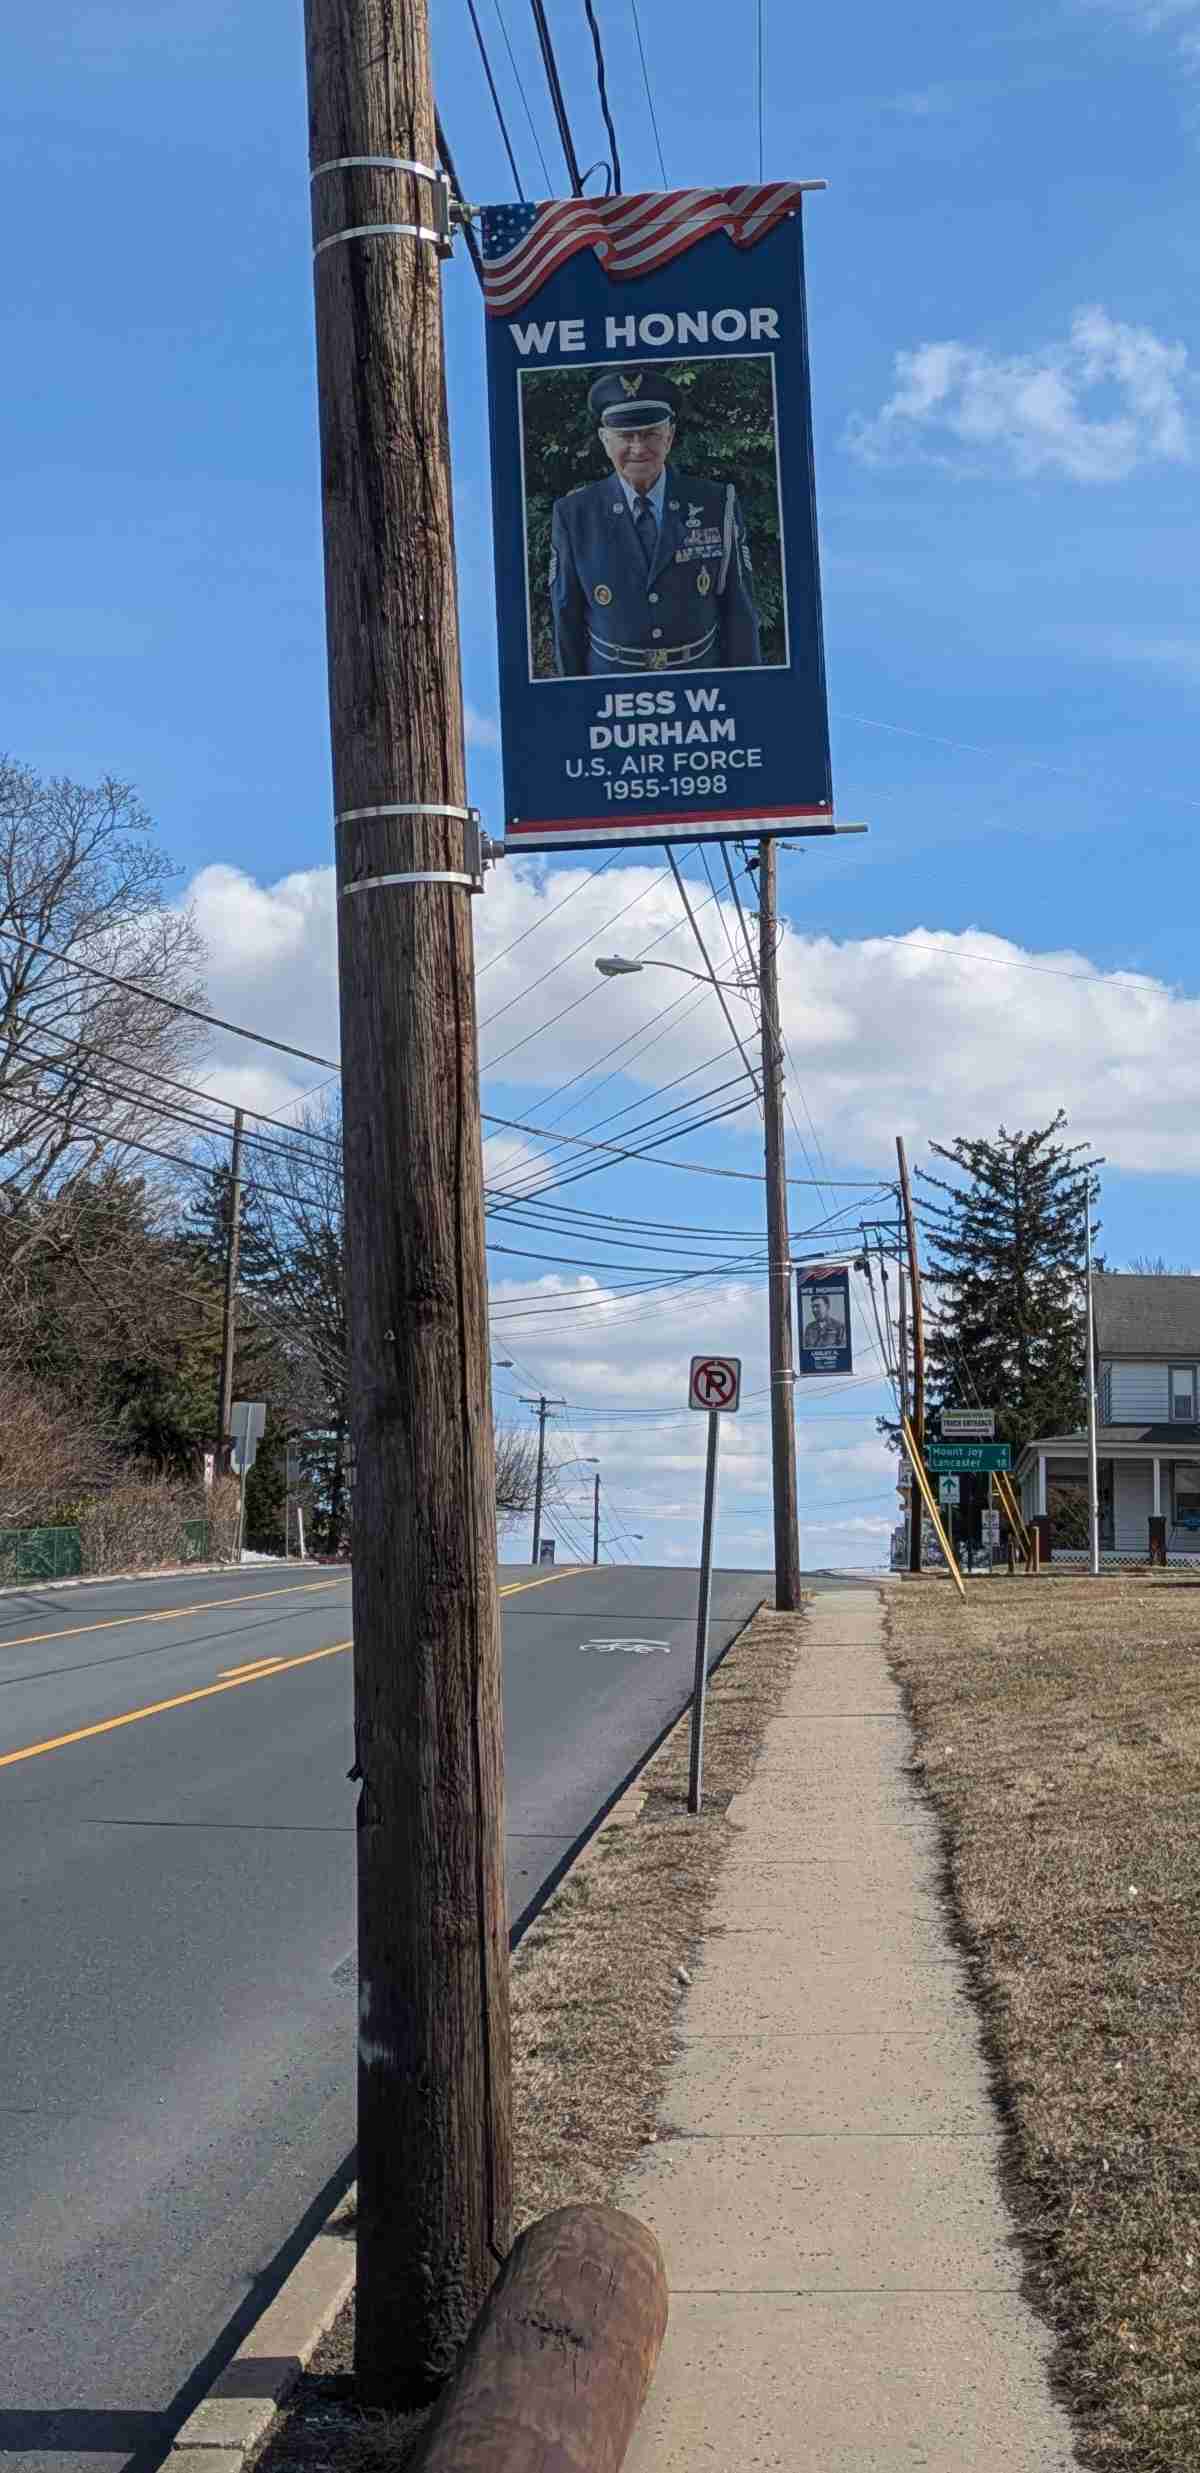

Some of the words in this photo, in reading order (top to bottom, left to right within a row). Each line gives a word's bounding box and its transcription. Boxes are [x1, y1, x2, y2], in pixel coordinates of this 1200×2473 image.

[509, 319, 586, 355] WE
[606, 307, 781, 348] HONOR
[597, 691, 676, 718] JESS
[685, 688, 726, 713] W.
[589, 718, 736, 750] DURHAM
[565, 757, 612, 778] U.S.
[620, 754, 665, 775] AIR
[673, 749, 763, 772] FORCE
[603, 774, 728, 800] 1955-1998
[932, 1447, 963, 1456] Mount
[968, 1447, 984, 1458] Joy
[933, 1459, 981, 1468] Lancaster
